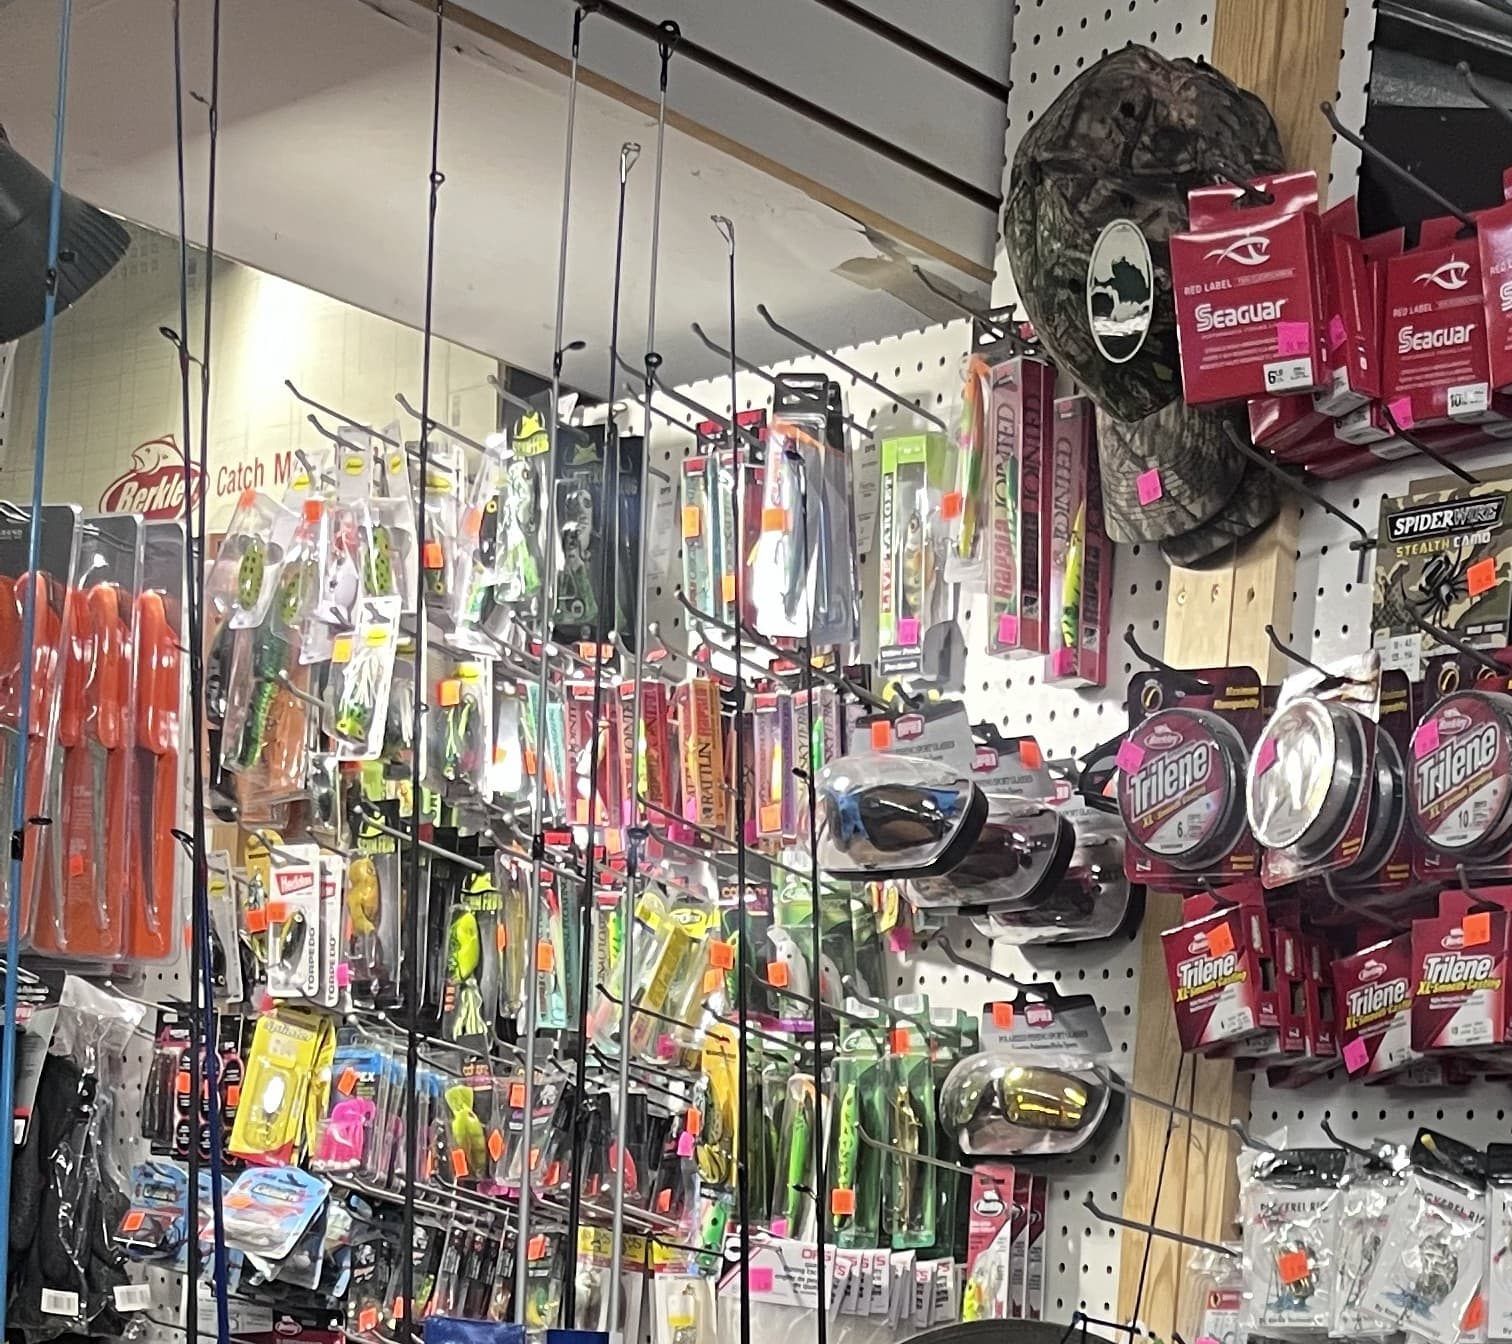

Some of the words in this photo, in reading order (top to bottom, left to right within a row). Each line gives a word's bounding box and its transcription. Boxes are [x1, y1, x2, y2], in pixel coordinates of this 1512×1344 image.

[1184, 285, 1202, 295] RED
[1204, 279, 1232, 293] LABEL
[1392, 307, 1408, 317] RED
[1409, 302, 1433, 313] LABEL
[216, 463, 265, 496] Catch
[1393, 503, 1500, 536] SPIDERWIRE
[1396, 539, 1450, 556] STEALTH
[1453, 531, 1491, 546] CAMO
[1129, 747, 1213, 817] Trilene
[1416, 734, 1498, 799] Trilene
[307, 926, 317, 992] TORPEDO
[1176, 950, 1237, 990] Trilene
[1423, 958, 1495, 987] Trilene
